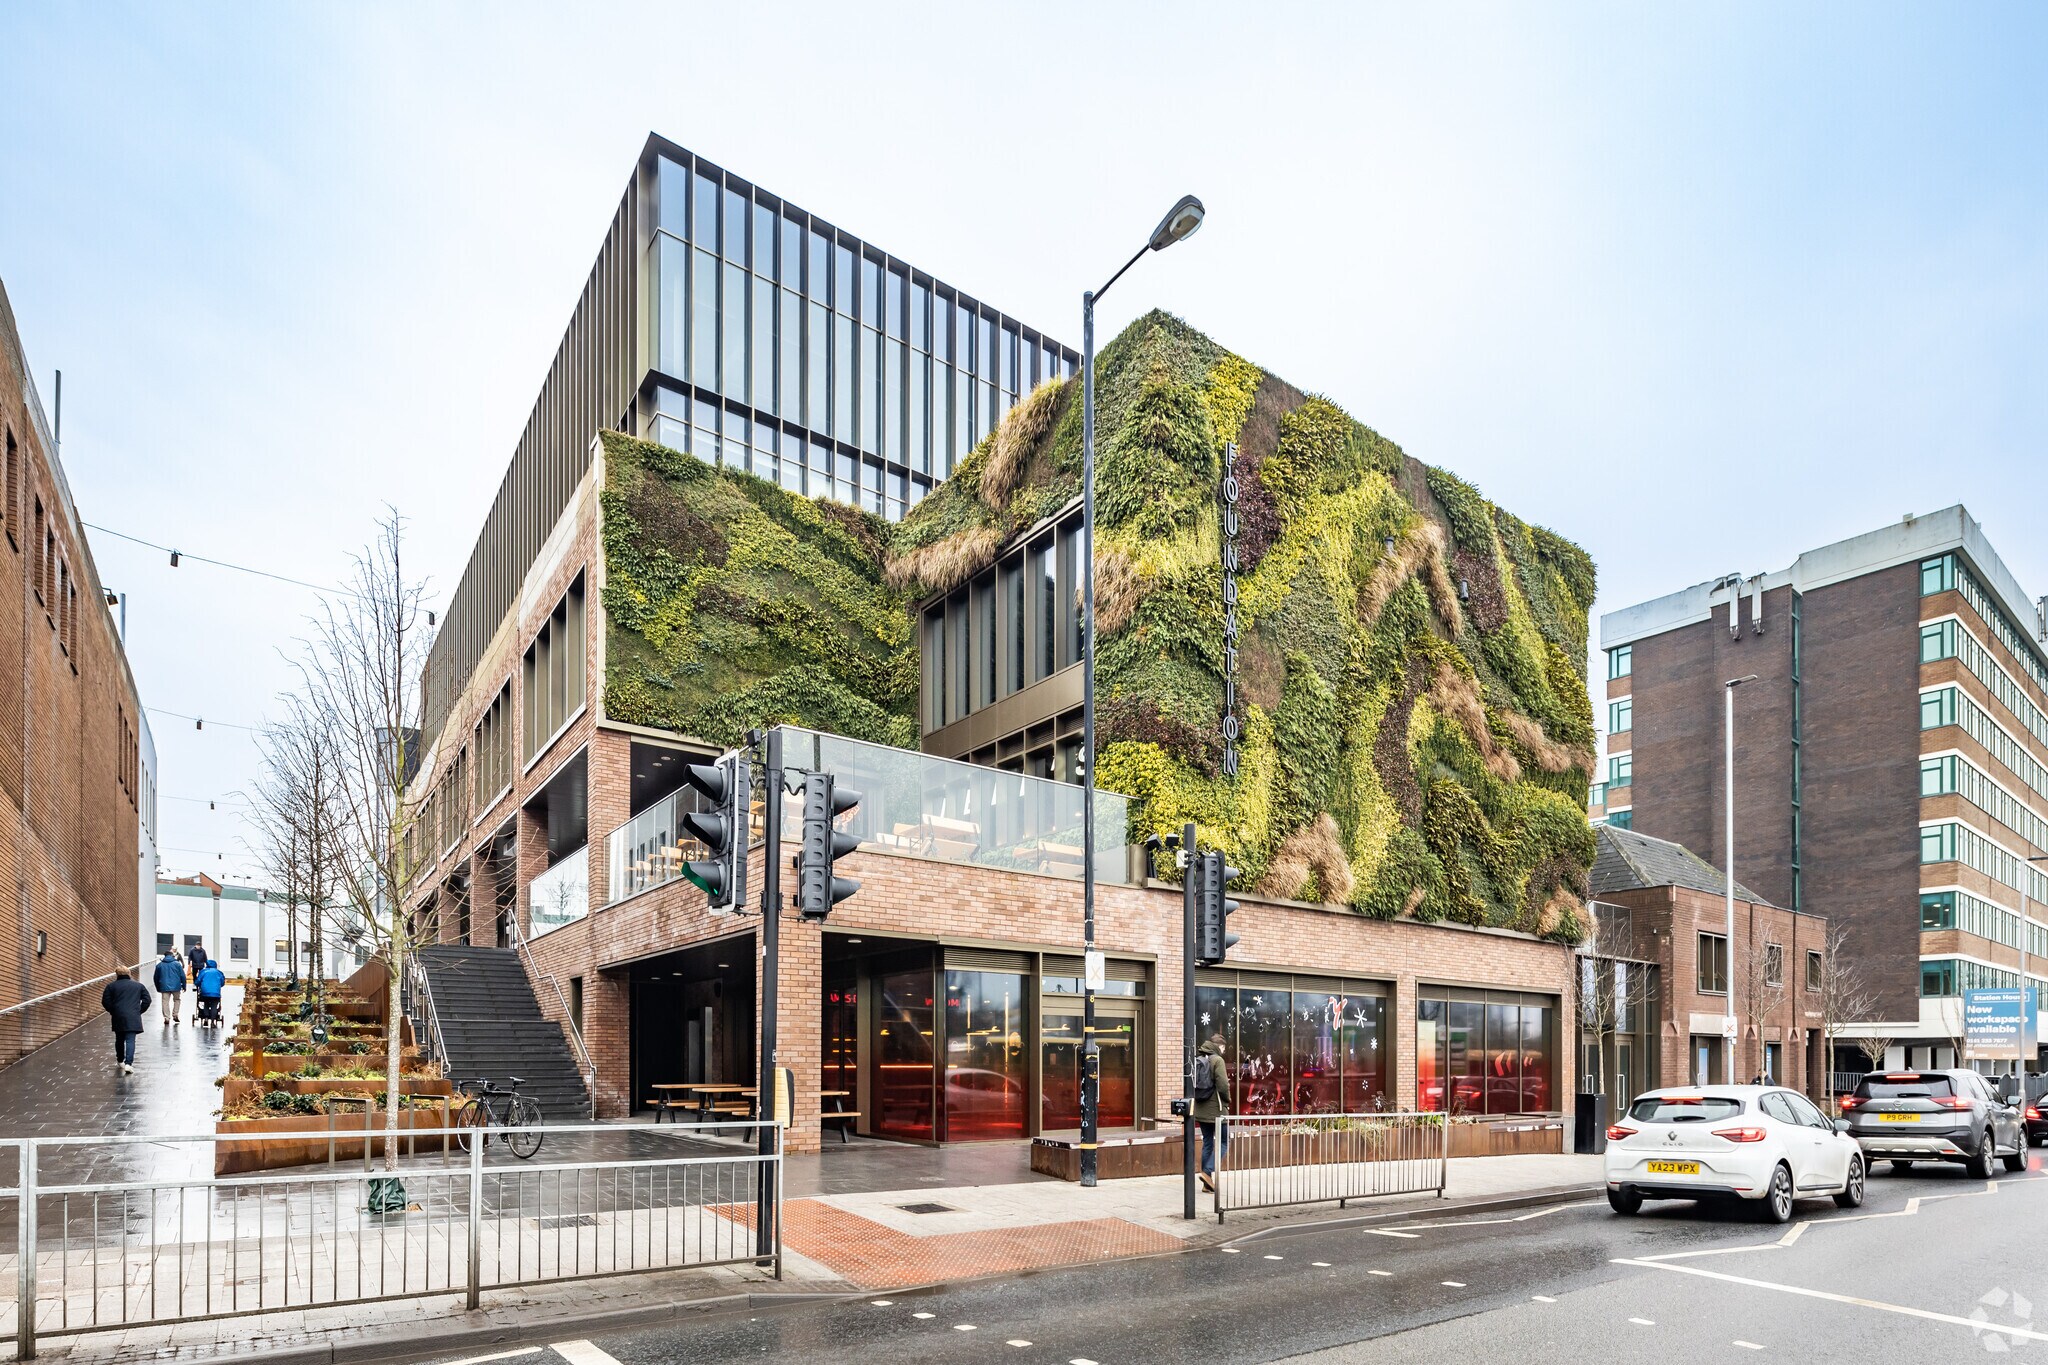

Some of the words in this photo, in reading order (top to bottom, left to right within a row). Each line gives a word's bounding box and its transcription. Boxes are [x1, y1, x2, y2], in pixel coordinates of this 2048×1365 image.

[1223, 442, 1239, 774] FOUNDATION
[1090, 994, 1095, 1002] 8
[1967, 1005, 1993, 1014] New
[1967, 1025, 2017, 1034] available
[1651, 1162, 1675, 1171] YA23
[1678, 1163, 1696, 1173] WPX
